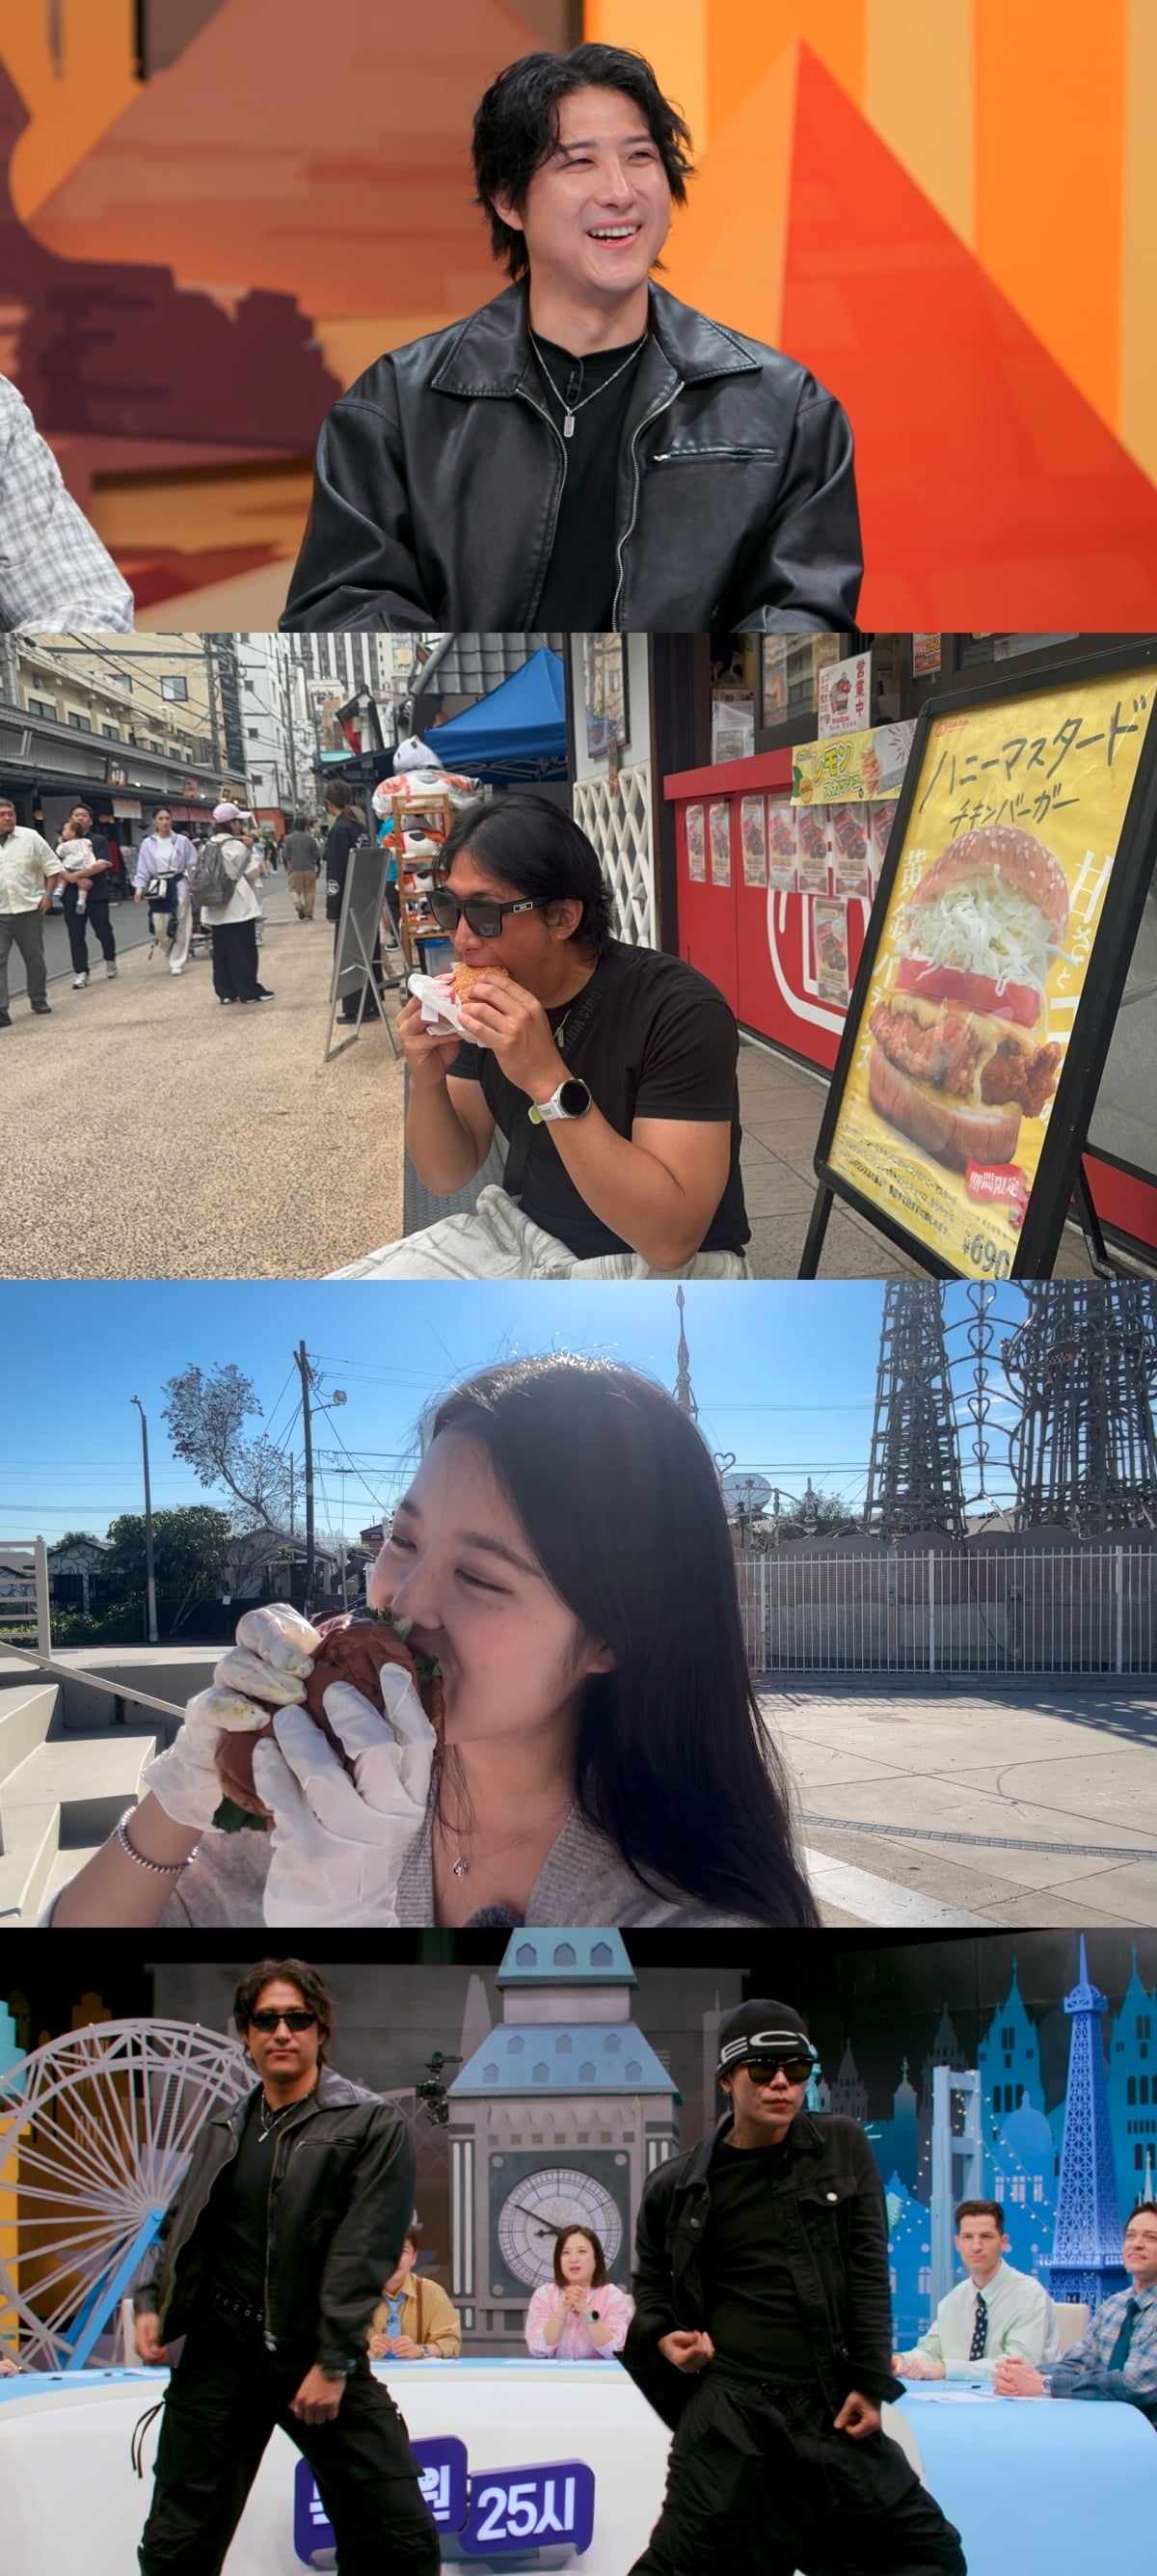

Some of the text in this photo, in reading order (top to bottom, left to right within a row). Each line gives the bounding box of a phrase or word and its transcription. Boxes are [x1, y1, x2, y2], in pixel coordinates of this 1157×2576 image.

[919, 694, 1147, 814] ハニーマスタード
[950, 782, 1081, 839] チキンバーガー
[476, 2477, 576, 2541] 25시
